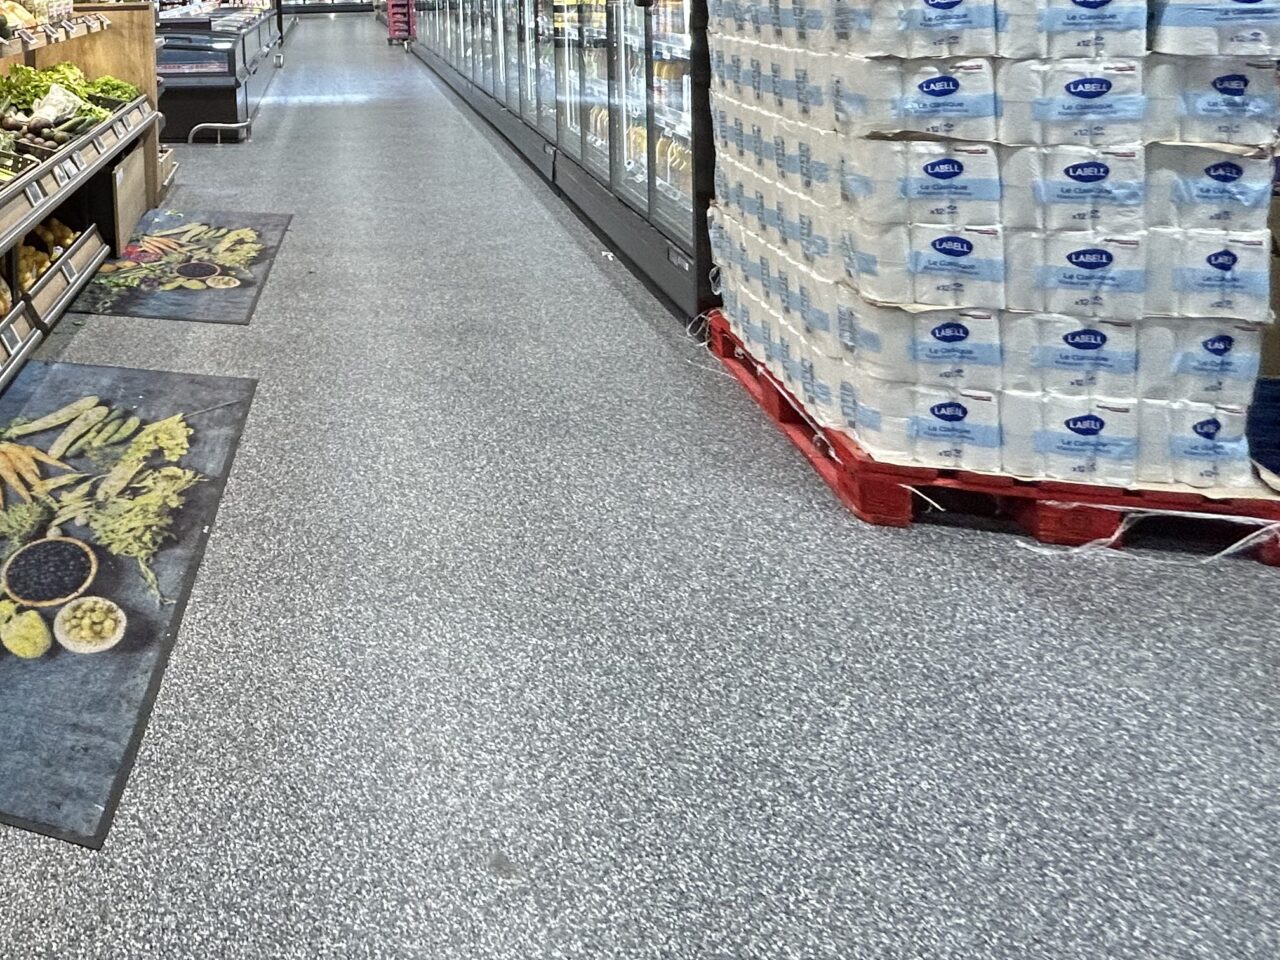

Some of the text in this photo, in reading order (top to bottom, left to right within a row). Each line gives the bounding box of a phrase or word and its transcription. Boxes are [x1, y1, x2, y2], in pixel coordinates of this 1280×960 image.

[927, 163, 960, 174] LABELL
[1069, 166, 1106, 177] LABELL
[934, 239, 970, 253] LABELL
[1071, 252, 1108, 263] LABELL
